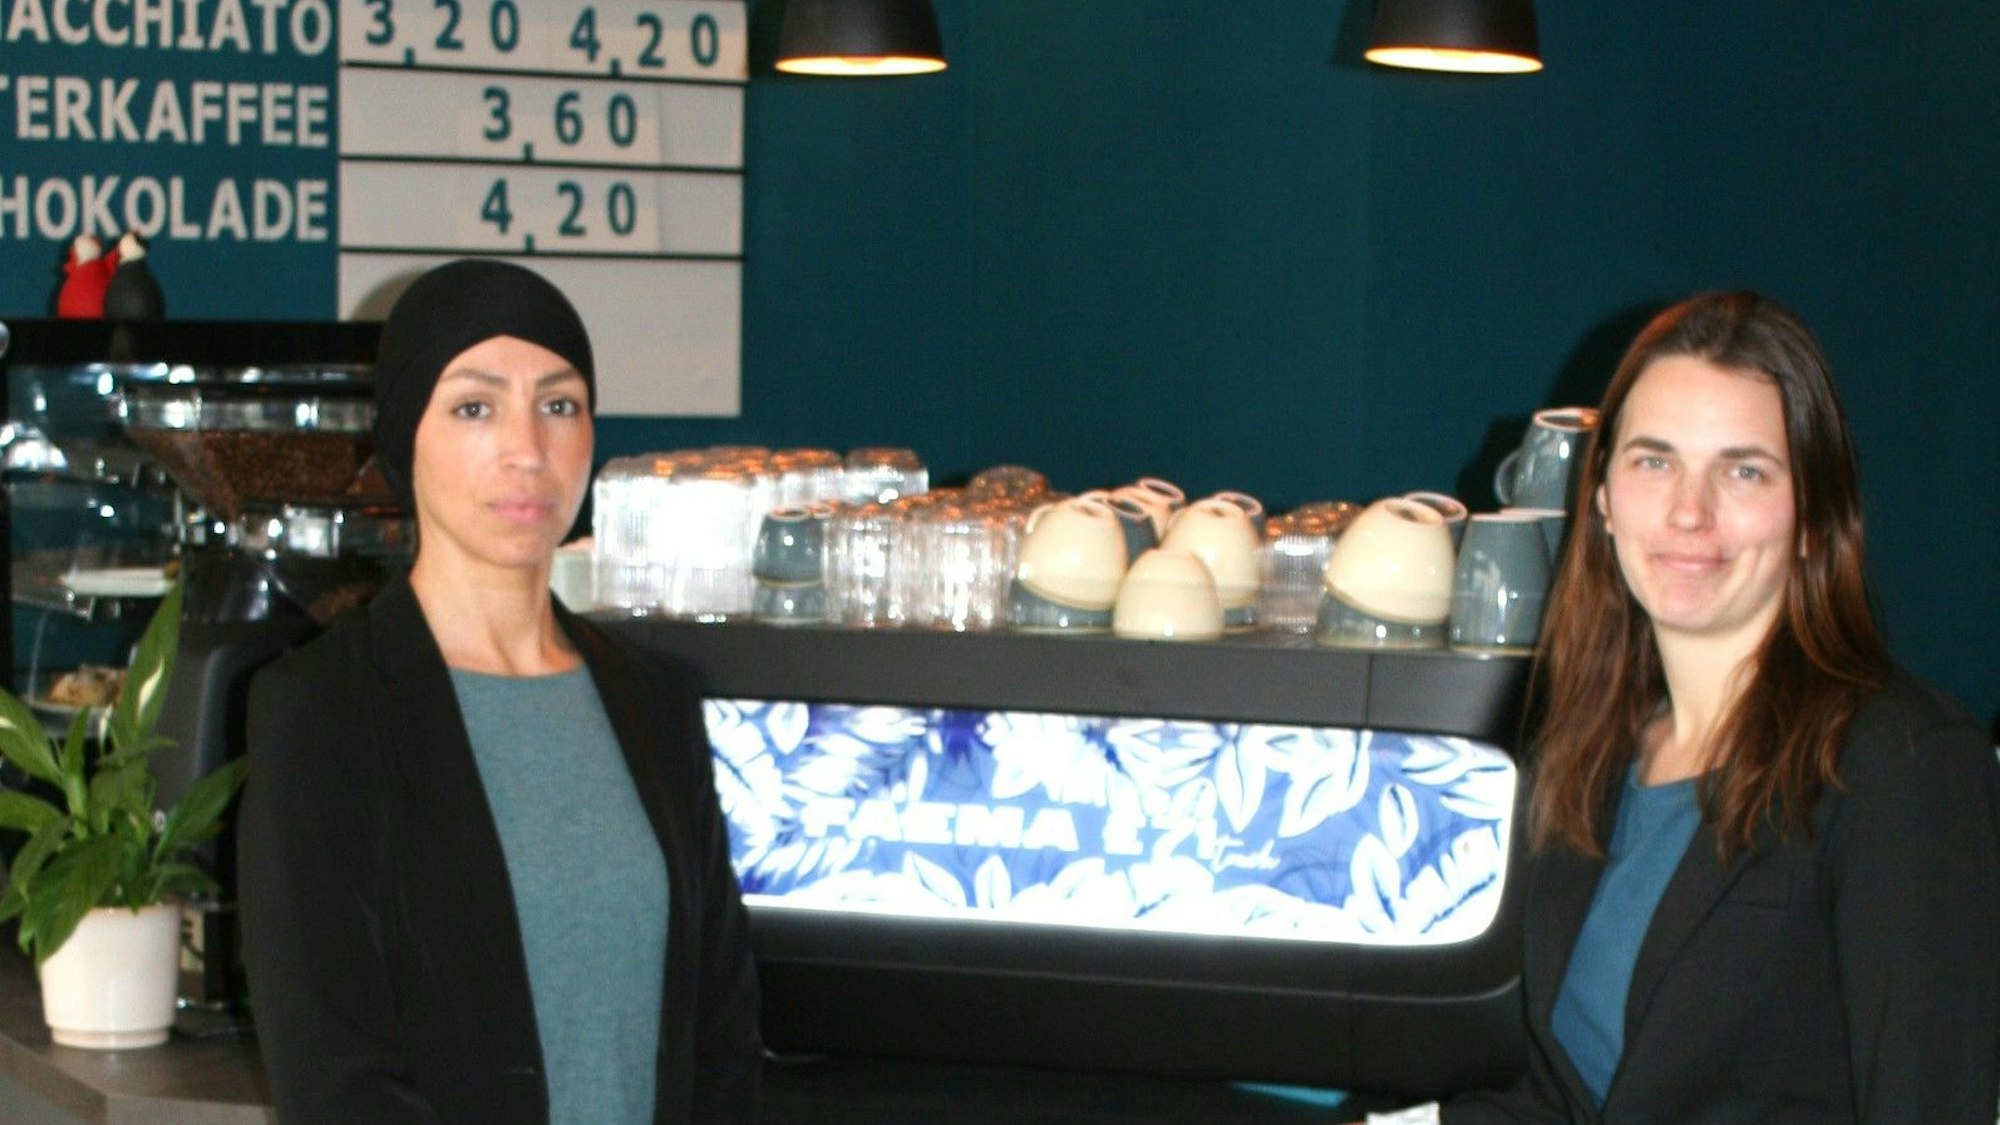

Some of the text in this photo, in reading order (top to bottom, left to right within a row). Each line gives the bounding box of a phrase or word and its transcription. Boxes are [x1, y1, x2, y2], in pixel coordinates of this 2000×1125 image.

[0, 0, 332, 55] ACCHIATO
[482, 86, 638, 161] 3,60
[0, 174, 328, 241] HOKOLADE
[480, 177, 637, 250] 4,20
